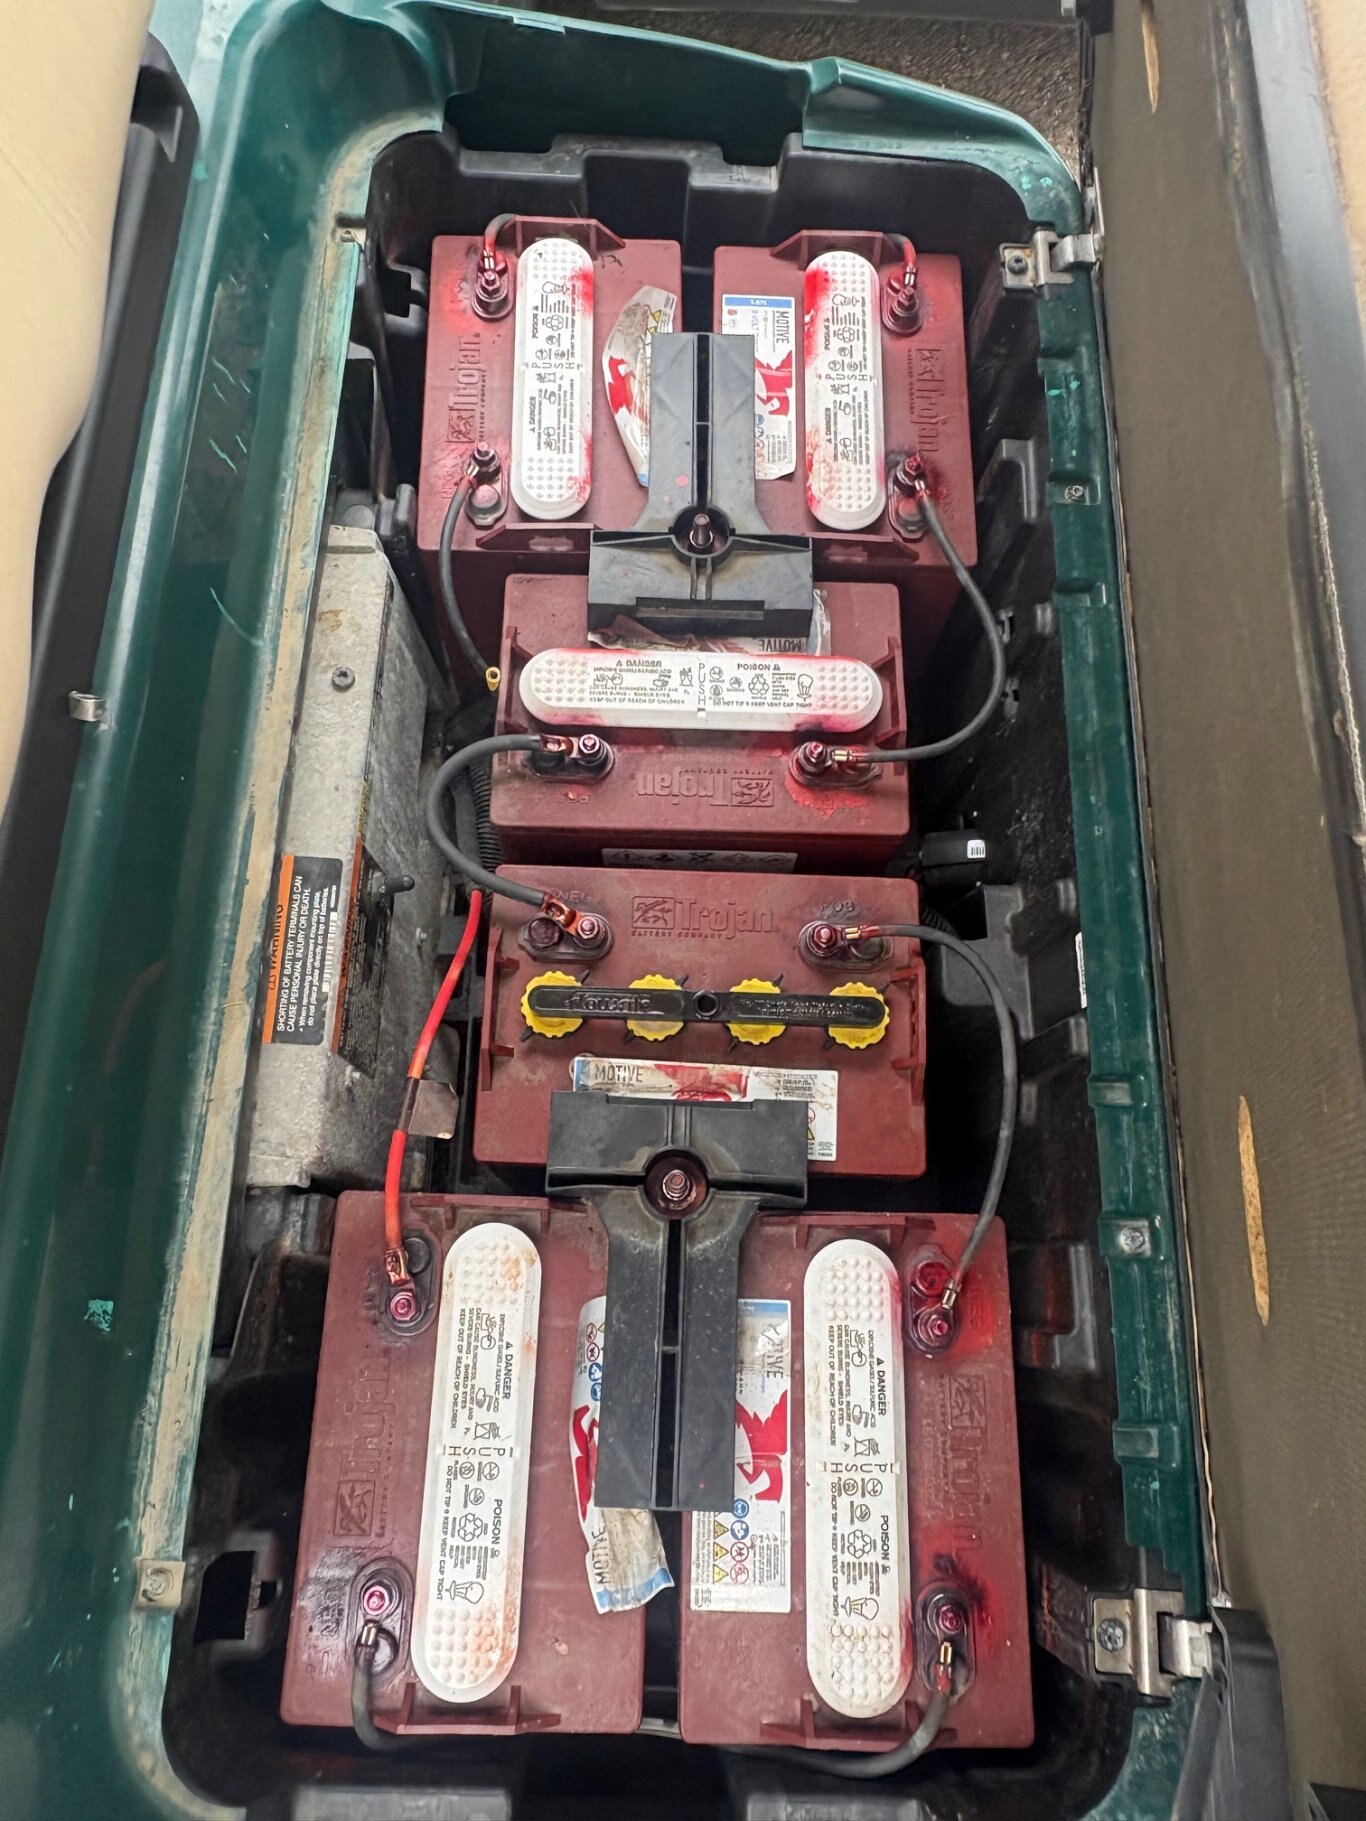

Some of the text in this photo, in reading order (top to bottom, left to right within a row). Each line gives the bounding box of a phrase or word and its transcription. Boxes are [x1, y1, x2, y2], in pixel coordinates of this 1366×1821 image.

[777, 311, 790, 344] MOTIVE
[448, 337, 485, 408] Trojan
[626, 660, 662, 668] DANGER
[737, 663, 771, 671] POISON
[698, 663, 706, 706] PUSH
[636, 767, 729, 807] Trojan
[310, 909, 320, 938] mounting
[676, 896, 773, 941] Trojan
[317, 935, 324, 944] on
[277, 876, 303, 1032] SHORTING OF BATTERY TERMINALS CAN
[287, 888, 311, 1032] CAUSE PERSONAL INJURY OR DEATH.
[306, 939, 315, 975] component
[301, 976, 313, 1006] removing
[310, 986, 318, 1004] place
[298, 1007, 308, 1026] When
[307, 1017, 314, 1026] do
[308, 1005, 316, 1016] not
[595, 1064, 644, 1082] MOTIVE
[457, 1344, 464, 1354] OF
[455, 1356, 463, 1380] REACH
[503, 1354, 513, 1400] DANGER
[454, 1381, 461, 1391] OF
[877, 1370, 886, 1416] DANGER
[341, 1357, 396, 1481] Trojan
[448, 1445, 506, 1457] PUSH
[447, 1465, 453, 1477] DO
[831, 1463, 888, 1473] PUSH
[491, 1499, 503, 1545] POISON
[440, 1538, 448, 1558] VENT
[881, 1515, 890, 1561] POISON
[591, 1526, 611, 1584] MOTIVE
[437, 1577, 445, 1601] TIGHT
